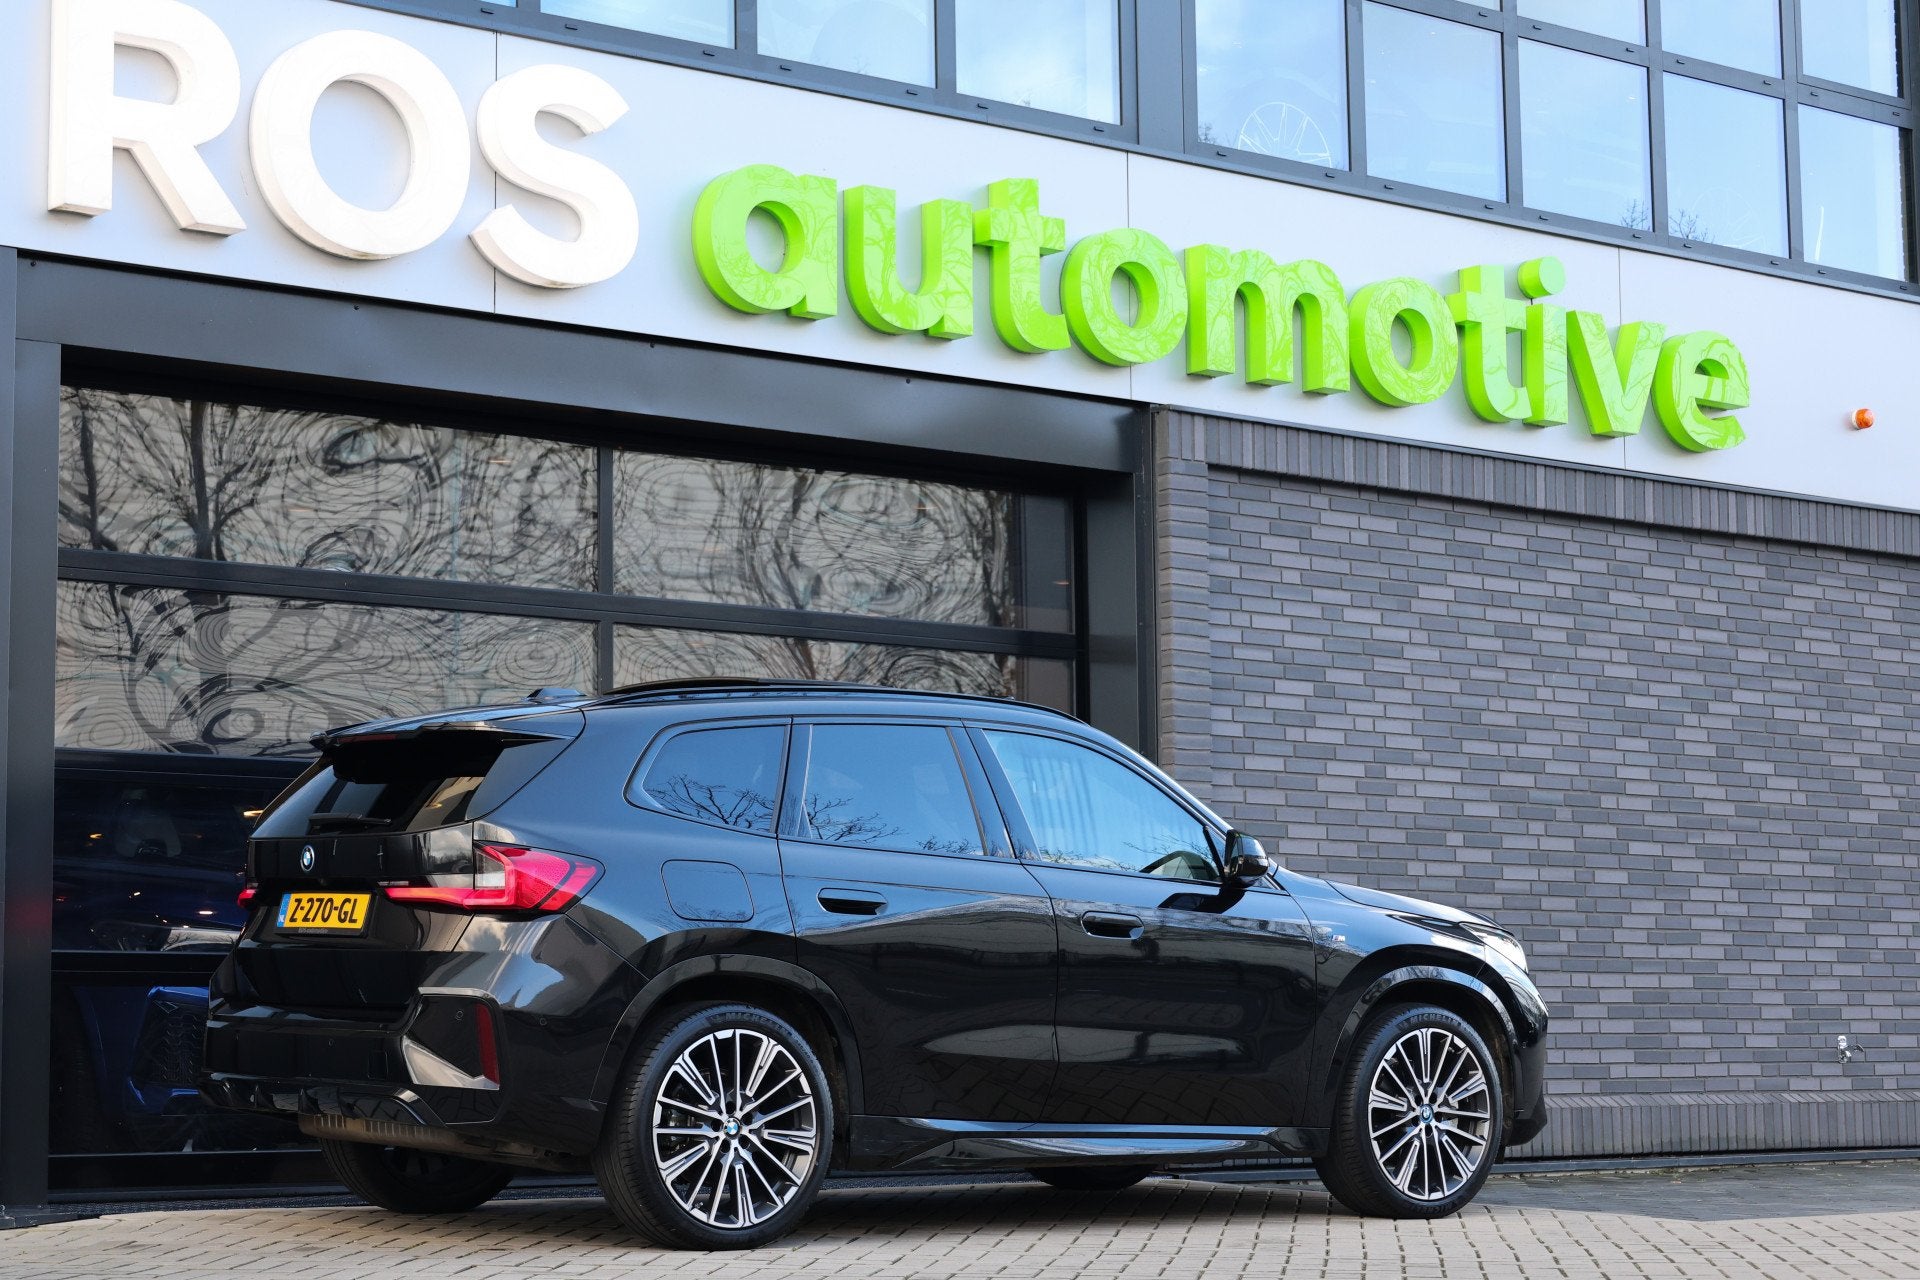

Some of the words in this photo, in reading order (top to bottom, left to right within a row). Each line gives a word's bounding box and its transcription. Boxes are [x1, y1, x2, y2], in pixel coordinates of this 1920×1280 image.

[47, 0, 640, 290] ROS
[691, 163, 1751, 453] automotive
[289, 897, 358, 923] Z-270-GL
